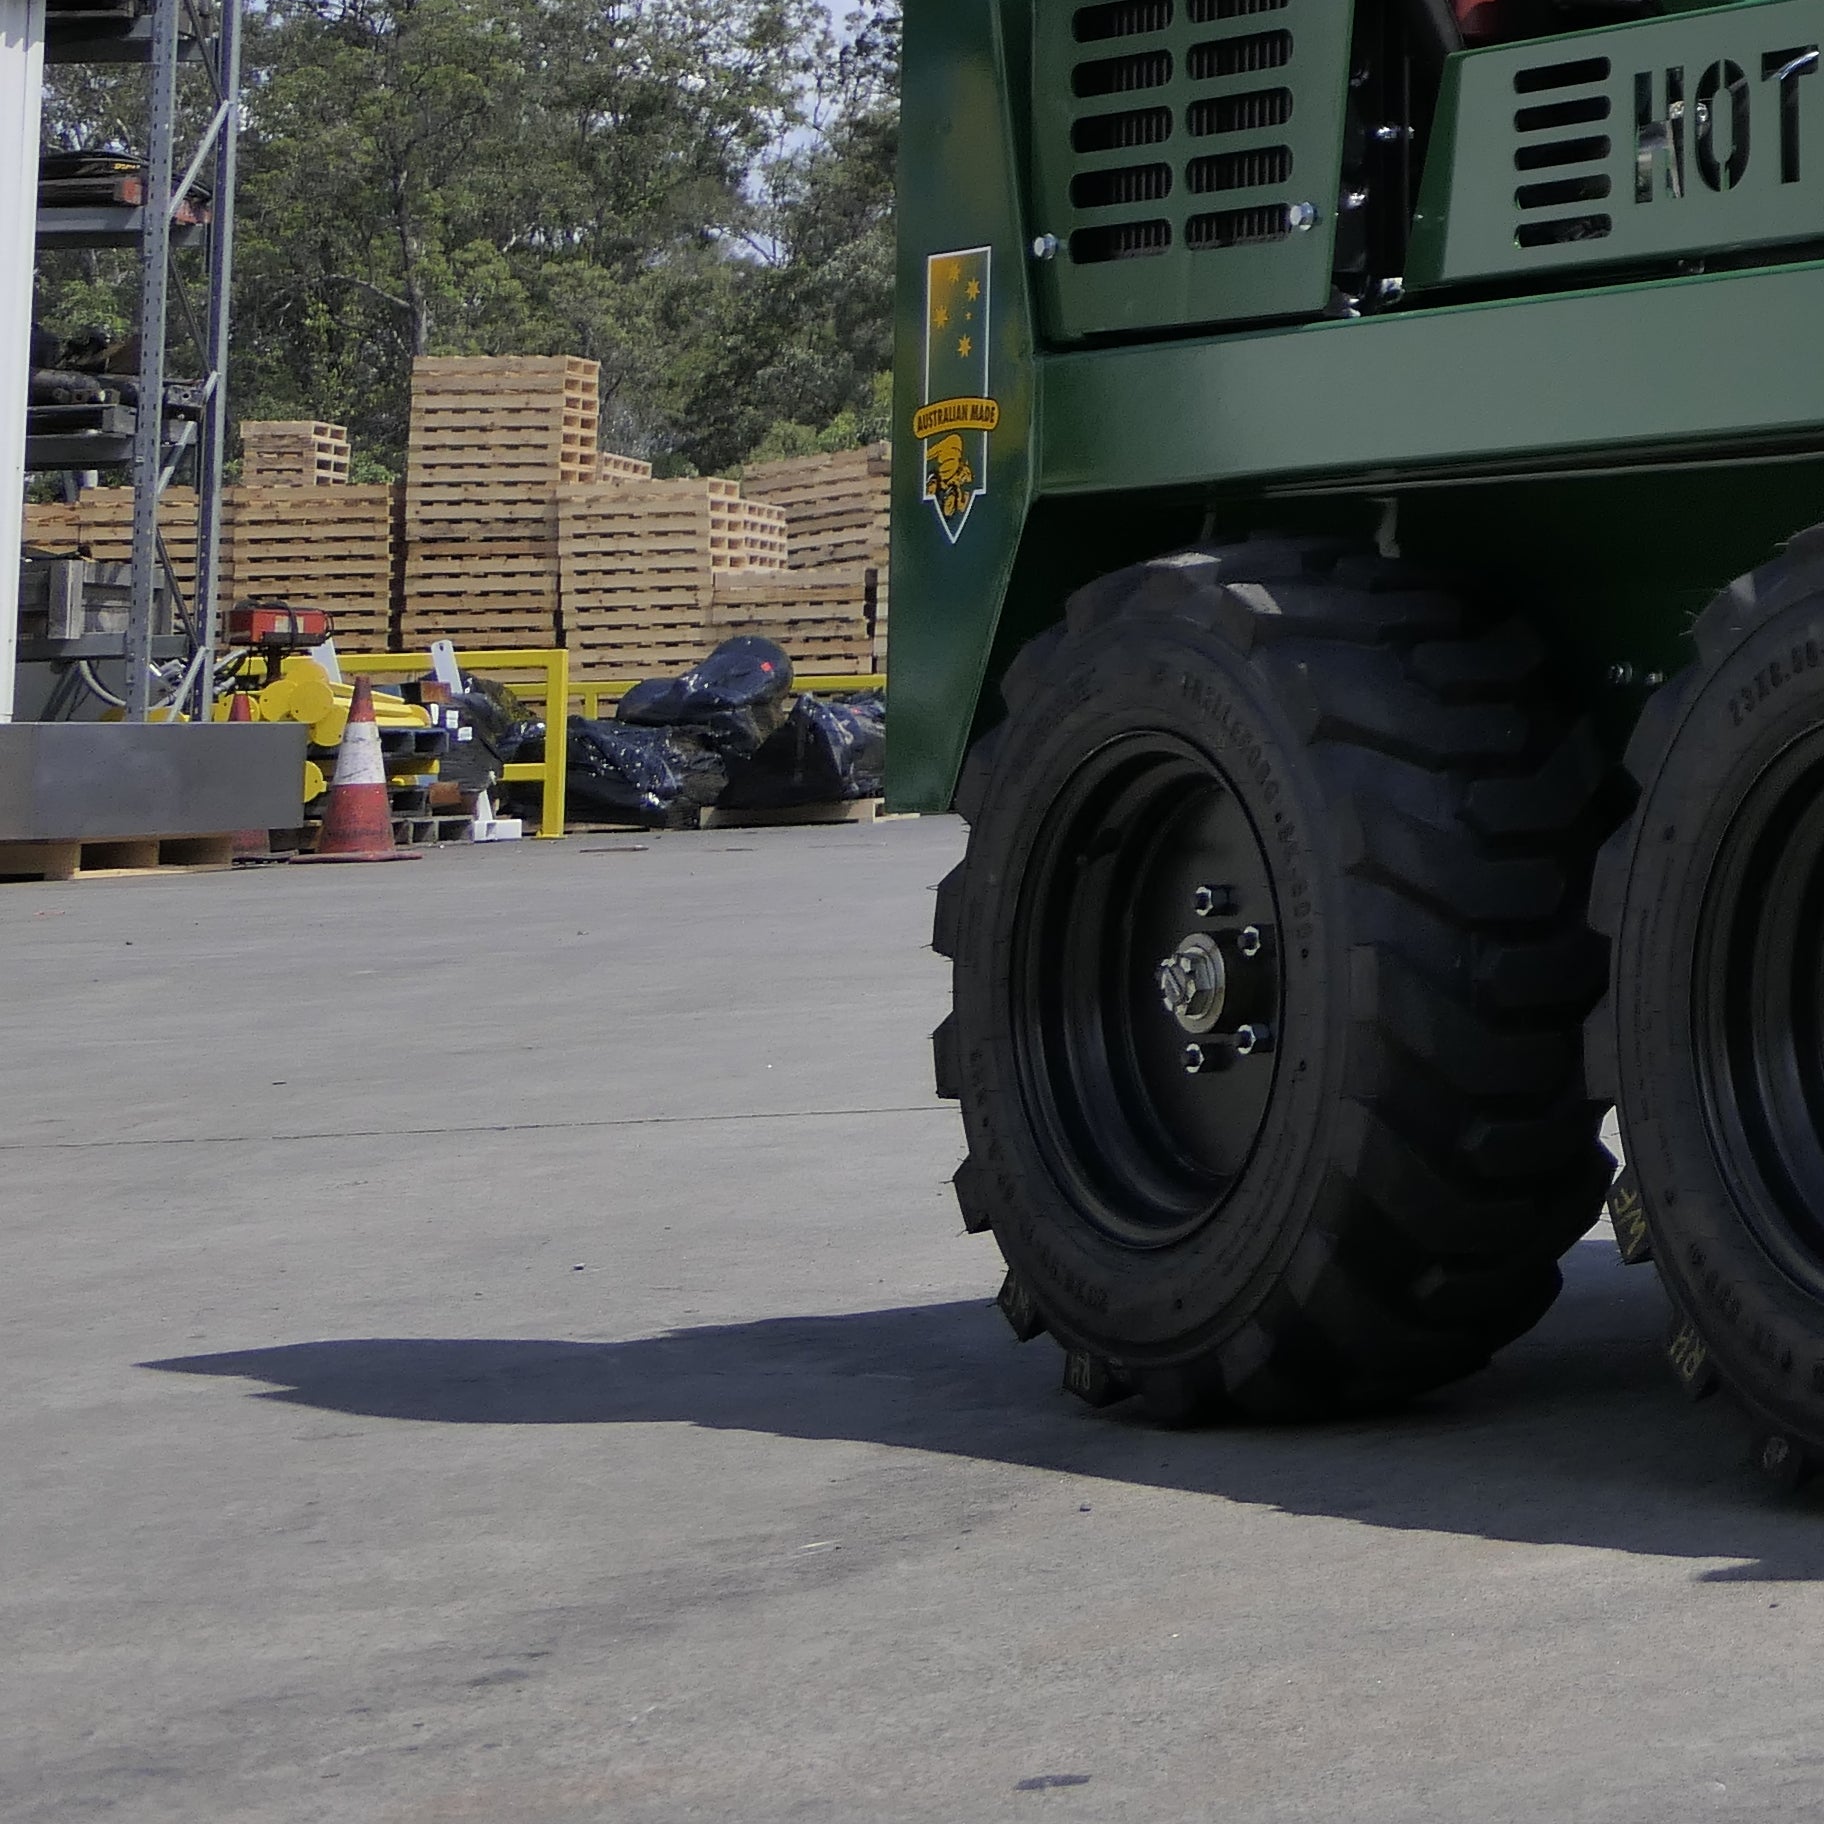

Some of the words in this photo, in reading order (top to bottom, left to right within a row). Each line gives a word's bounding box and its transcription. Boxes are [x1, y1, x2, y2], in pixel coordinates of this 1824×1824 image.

[1634, 44, 1820, 204] HOT
[917, 404, 968, 432] AUSTRALIAN
[970, 404, 995, 423] MADE
